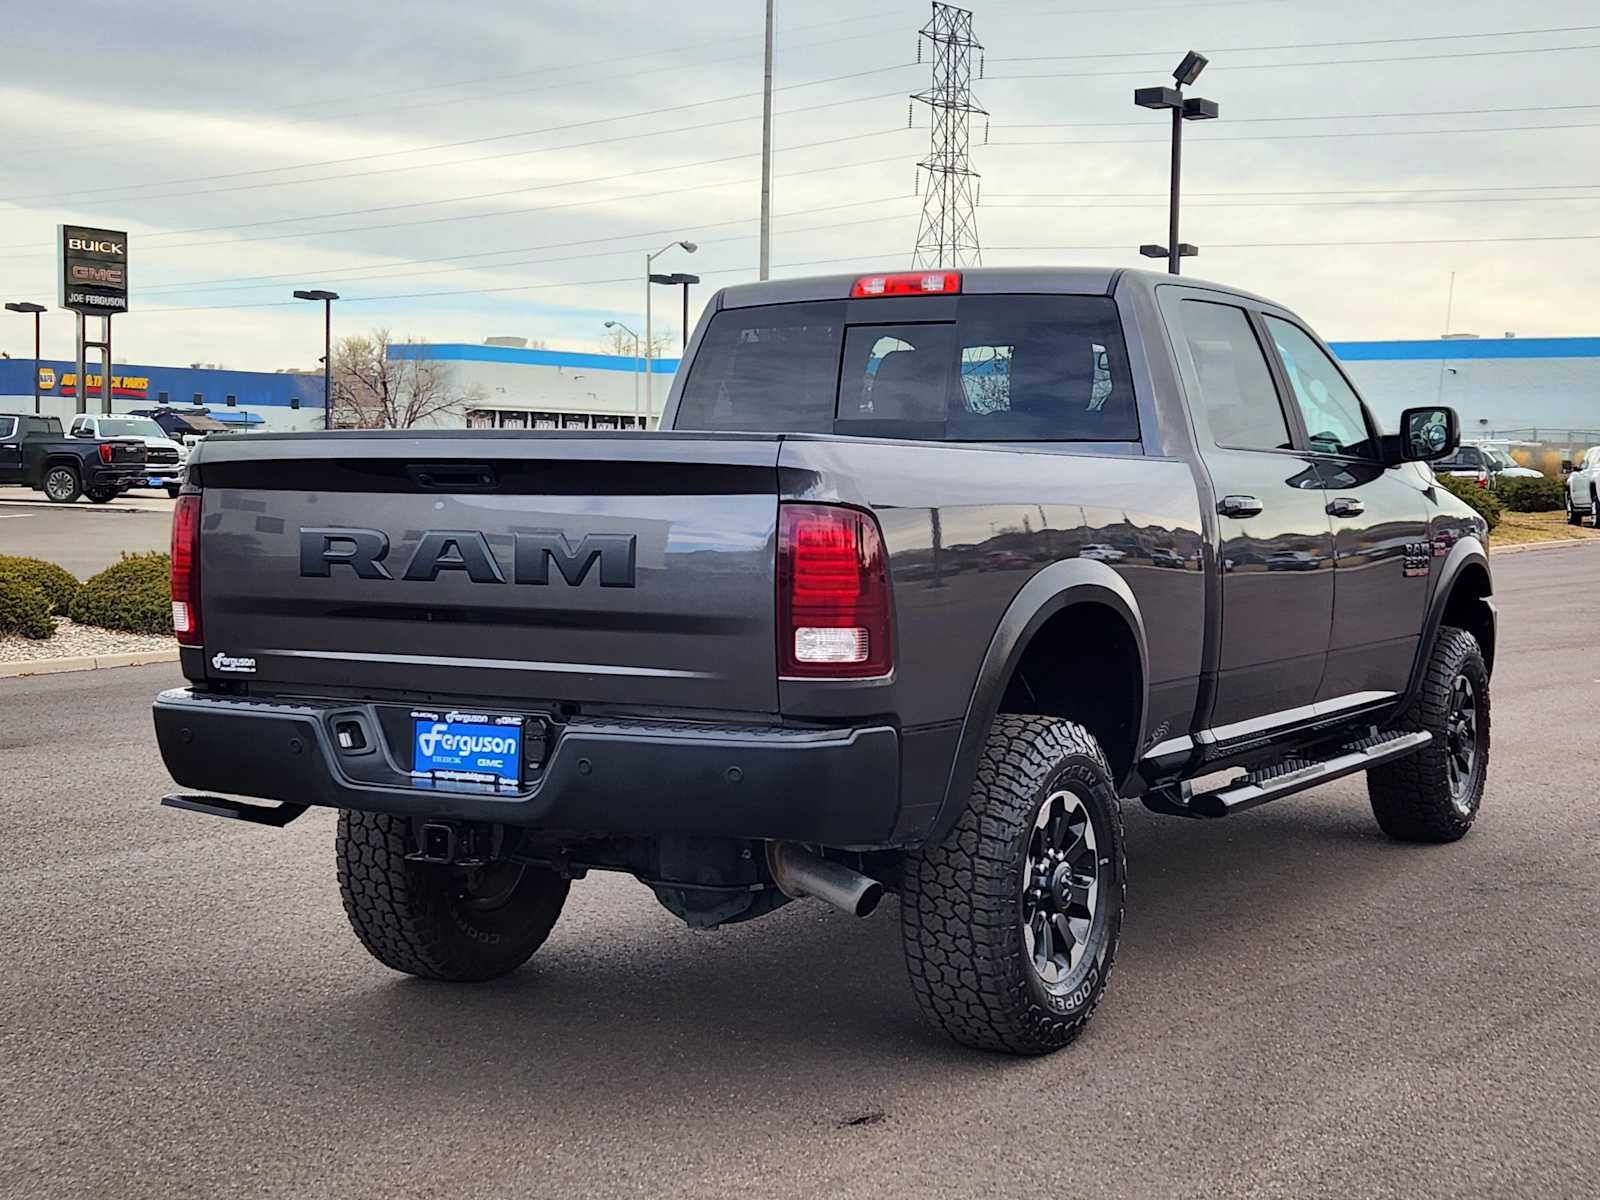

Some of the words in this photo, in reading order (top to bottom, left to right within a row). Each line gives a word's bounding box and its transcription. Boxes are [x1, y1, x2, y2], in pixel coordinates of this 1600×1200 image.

[68, 239, 124, 254] BUICK
[72, 266, 122, 283] GMC
[69, 293, 85, 303] JOE
[85, 294, 127, 308] FERGUSON
[299, 526, 636, 588] RAM
[445, 710, 489, 723] Ferguson
[419, 723, 517, 757] Ferguson
[476, 758, 504, 768] GMC
[1047, 967, 1098, 1010] COOPER
